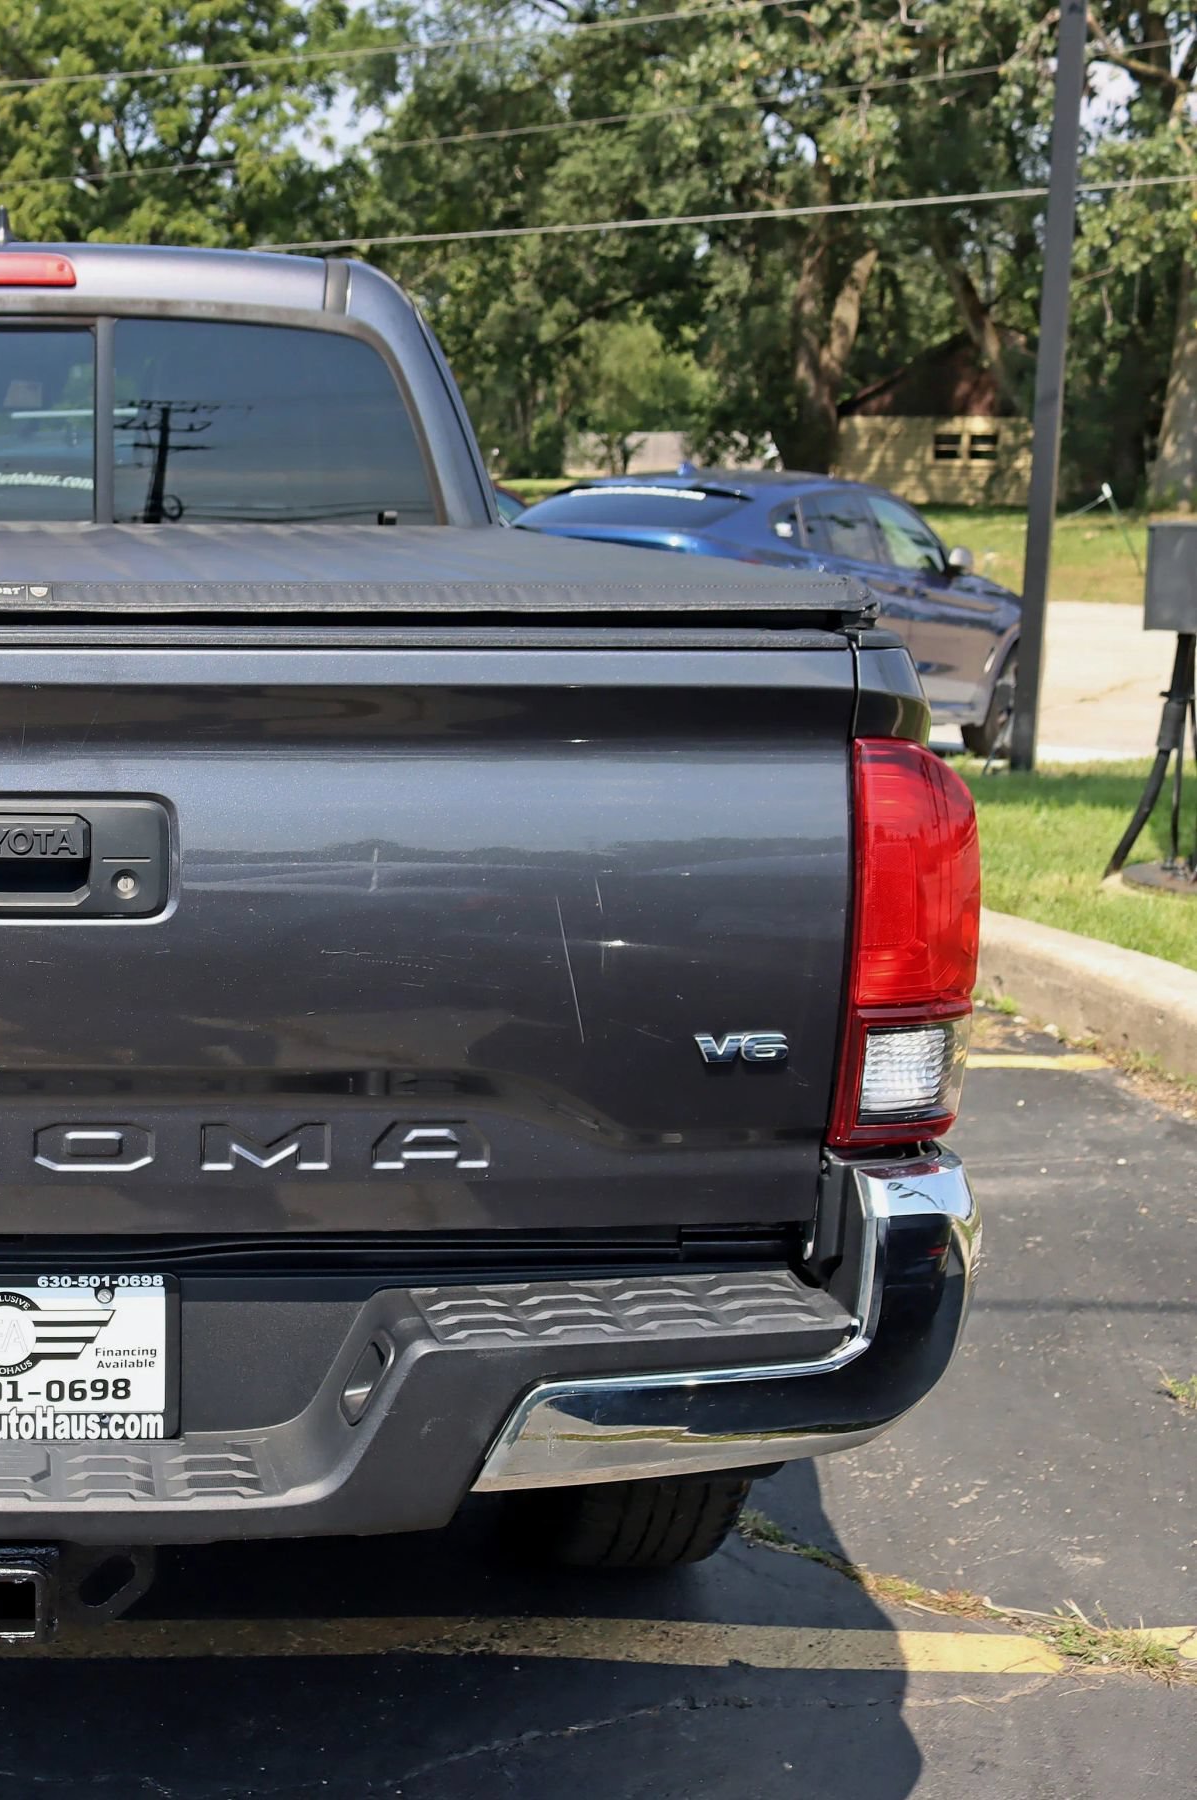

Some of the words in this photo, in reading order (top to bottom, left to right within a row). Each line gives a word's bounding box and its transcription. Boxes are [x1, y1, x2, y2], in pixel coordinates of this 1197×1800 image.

[694, 1032, 789, 1062] V6
[37, 1275, 164, 1288] 630-501-0698
[95, 1347, 157, 1358] Financing
[97, 1359, 155, 1368] Available
